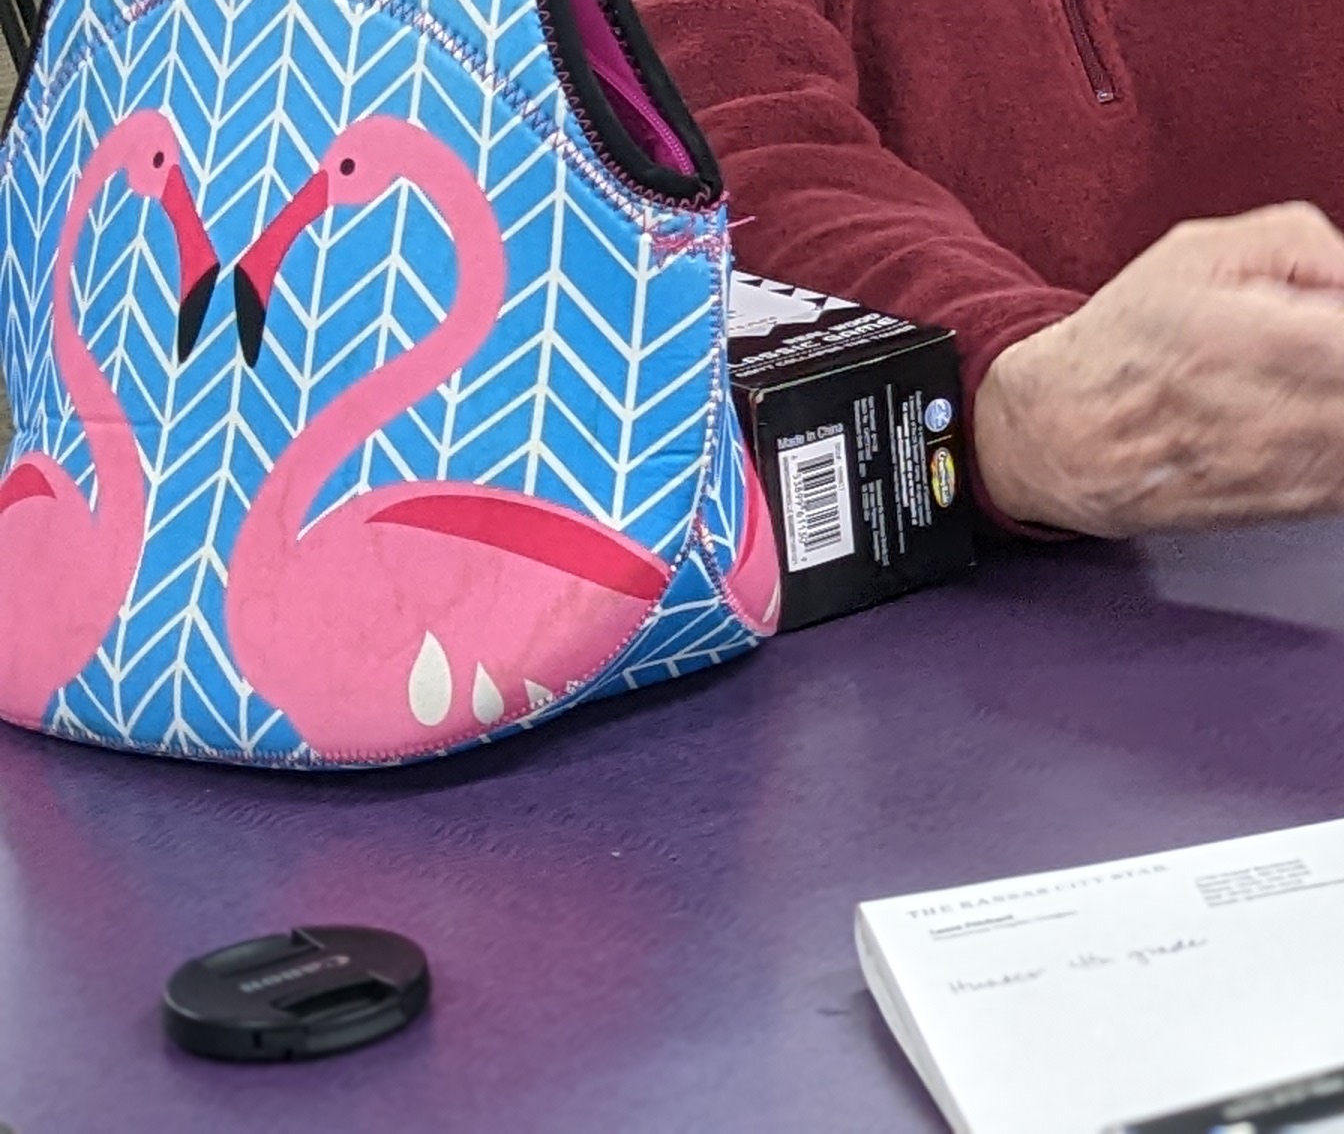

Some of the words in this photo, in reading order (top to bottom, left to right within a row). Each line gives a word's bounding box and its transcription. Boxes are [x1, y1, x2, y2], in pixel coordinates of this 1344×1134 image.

[822, 316, 900, 343] GAME
[777, 433, 805, 450] Made
[816, 422, 845, 439] China
[907, 902, 953, 920] THE
[959, 886, 1050, 911] KANSAS
[1054, 875, 1103, 892] CITY
[1109, 863, 1168, 881] STAR
